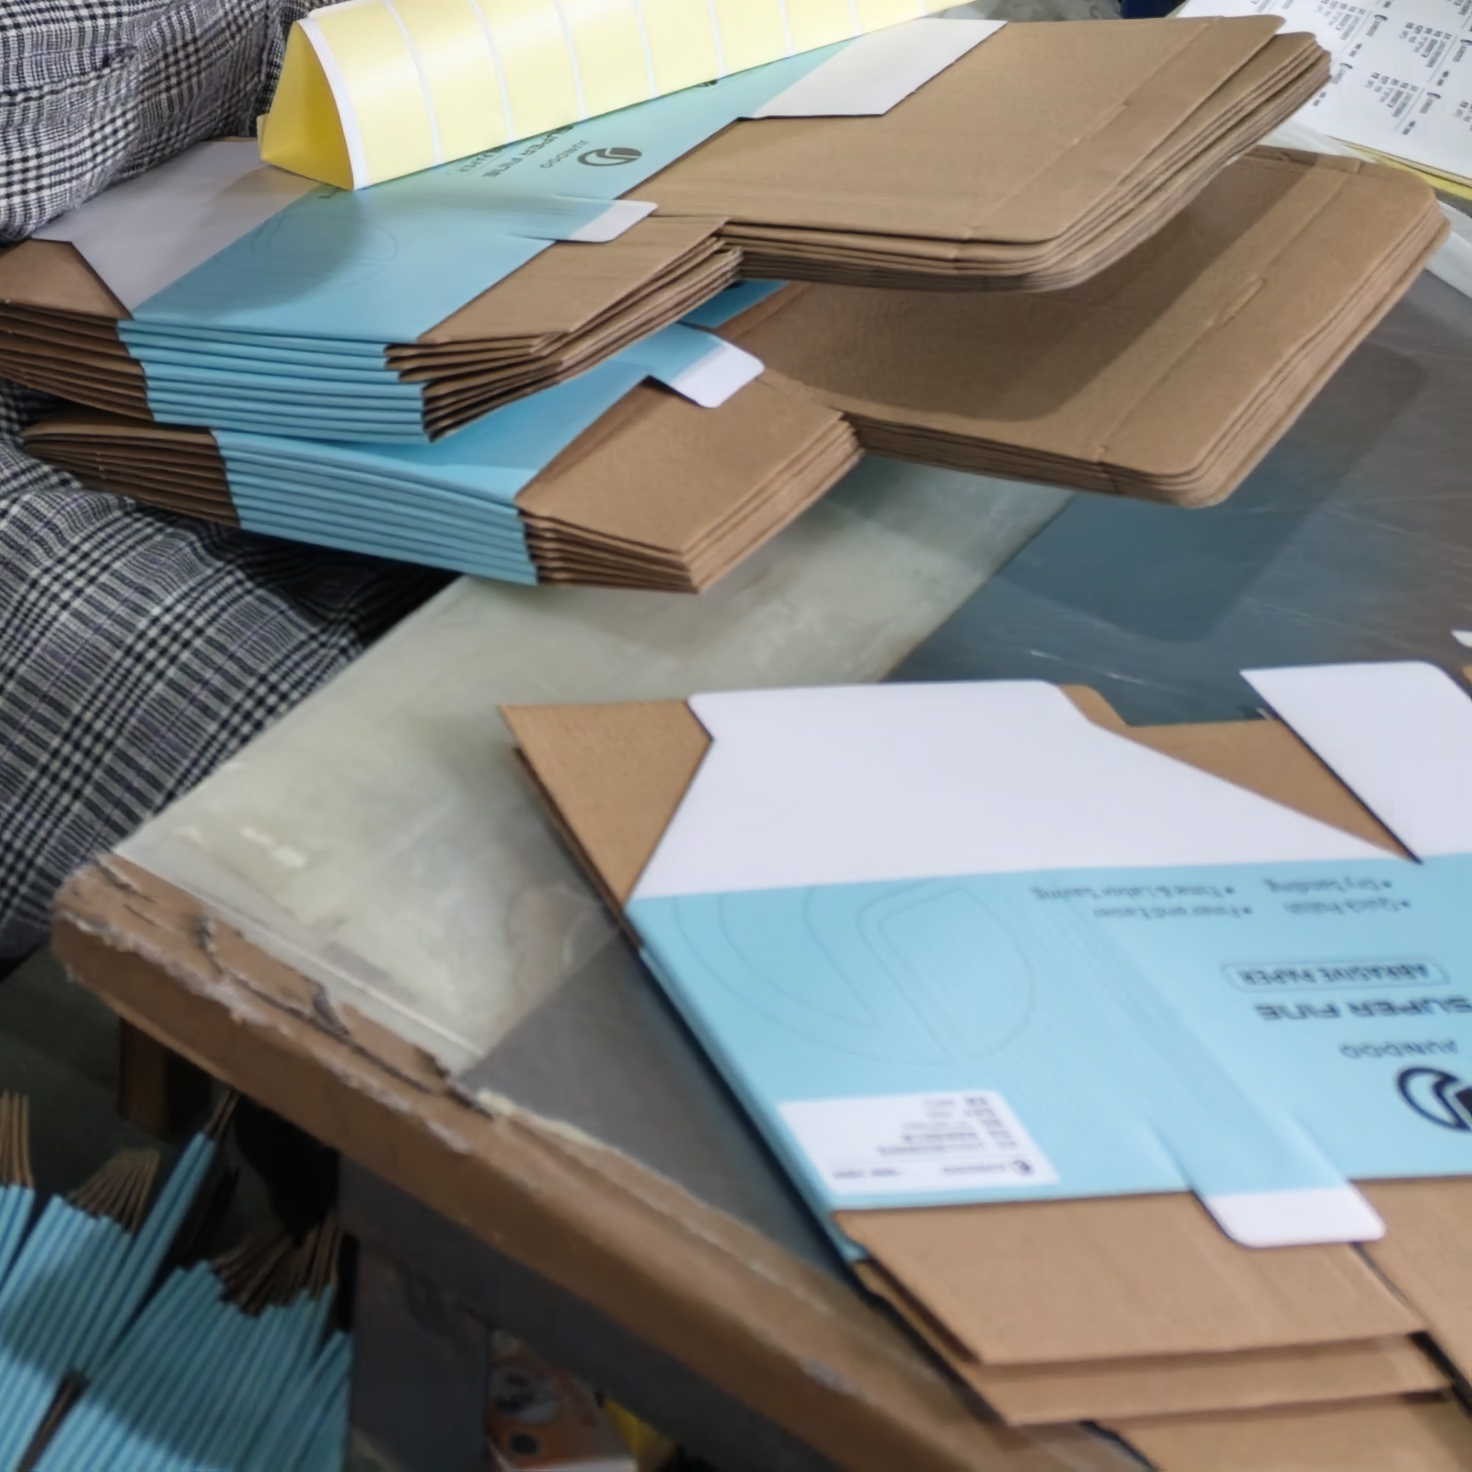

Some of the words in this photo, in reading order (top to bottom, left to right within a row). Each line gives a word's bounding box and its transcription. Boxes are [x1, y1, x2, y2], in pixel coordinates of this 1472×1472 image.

[1237, 968, 1318, 986] PAPER
[1318, 962, 1431, 983] ABRASIVE
[1255, 1003, 1343, 1021] FINE
[1348, 995, 1472, 1019] SUPER
